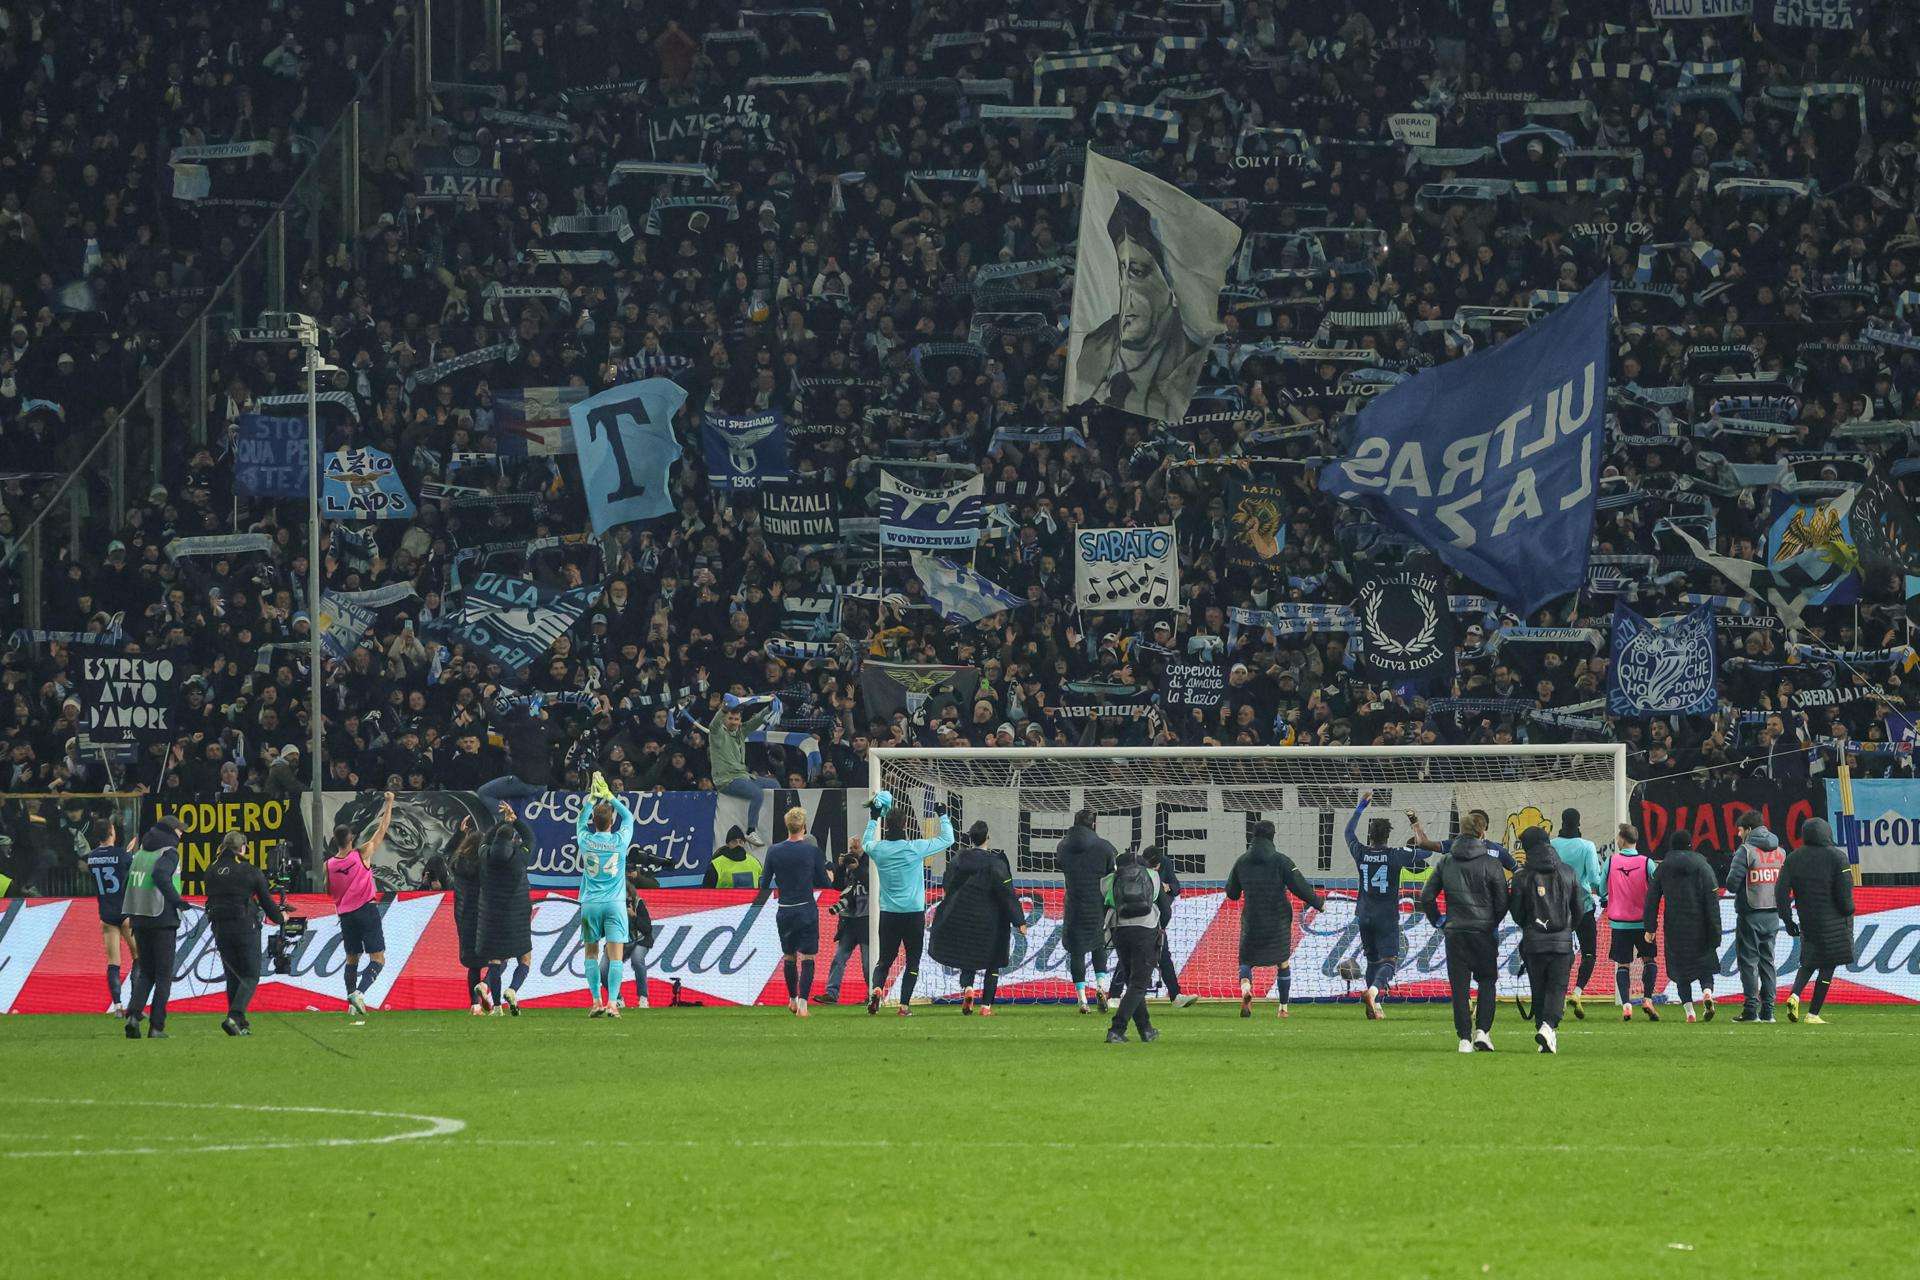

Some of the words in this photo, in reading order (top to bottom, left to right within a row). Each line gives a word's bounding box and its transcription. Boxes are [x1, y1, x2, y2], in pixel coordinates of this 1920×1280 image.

[1409, 131, 1430, 139] MALE
[250, 329, 290, 339] LAZIO
[1326, 384, 1376, 397] LAZIO
[729, 416, 774, 429] SPEZZIAMO
[1242, 484, 1282, 498] LAZIO
[326, 493, 406, 513] LADS
[770, 493, 830, 513] LAZIALI
[763, 516, 800, 535] SONO
[887, 532, 971, 547] WONDERWALL
[1078, 528, 1170, 563] SABATO
[1360, 579, 1377, 599] no
[1379, 573, 1438, 594] bullshit
[1741, 617, 1775, 627] LAZIO
[1369, 652, 1406, 671] curva
[1408, 645, 1445, 670] nord
[1629, 652, 1648, 665] IO
[1690, 646, 1707, 660] HO
[84, 658, 174, 682] ESTREMO
[1166, 664, 1223, 679] colpevoli
[1684, 659, 1709, 678] CHE
[1169, 673, 1182, 688] di
[1186, 677, 1224, 688] amare
[1627, 680, 1647, 696] HO
[99, 681, 157, 704] ATTO
[1167, 690, 1180, 703] la
[1184, 689, 1222, 705] Lazio
[1792, 688, 1836, 708] LIBERA
[1836, 687, 1852, 703] LA
[91, 706, 168, 730] D'AMORE
[583, 852, 619, 878] 94
[92, 866, 120, 896] 13
[1359, 863, 1389, 894] 14
